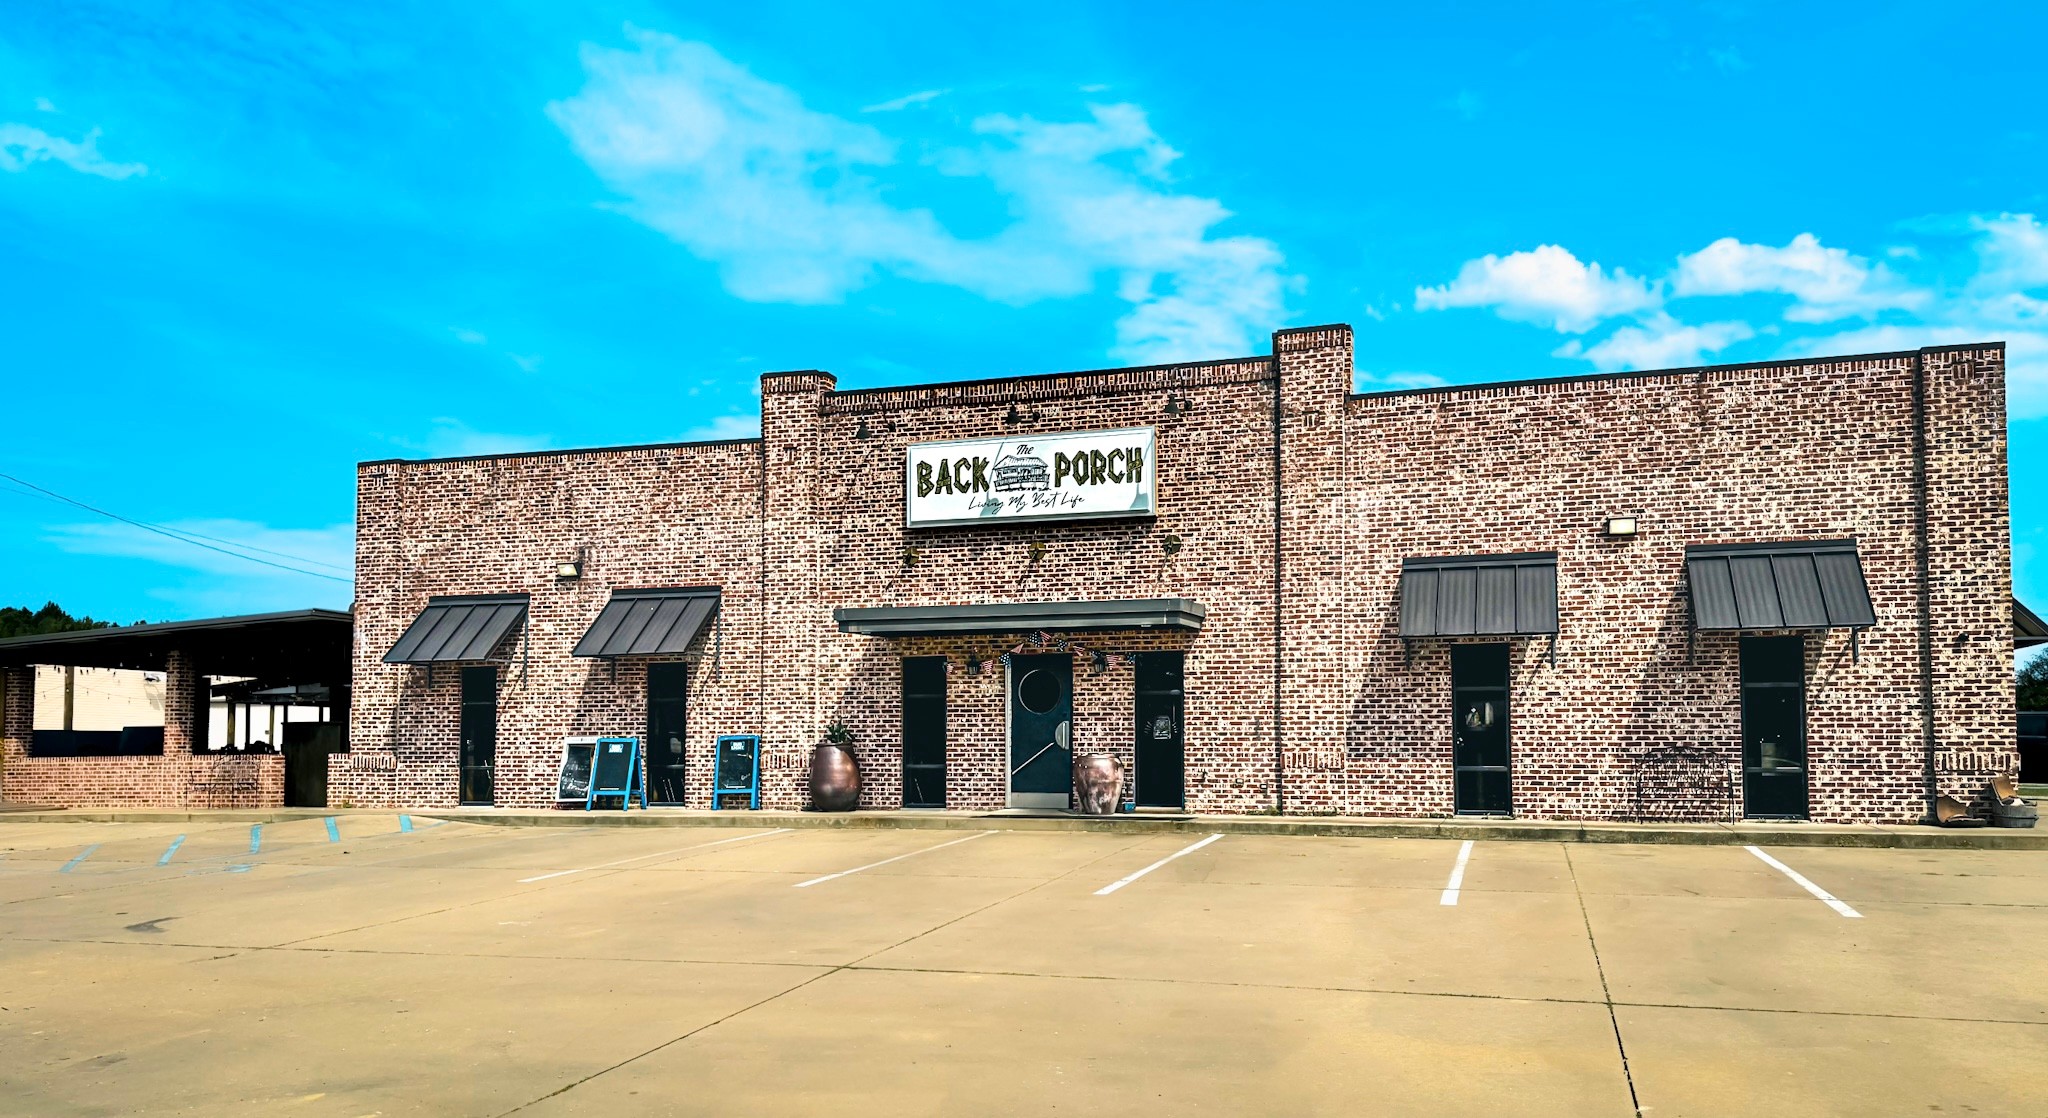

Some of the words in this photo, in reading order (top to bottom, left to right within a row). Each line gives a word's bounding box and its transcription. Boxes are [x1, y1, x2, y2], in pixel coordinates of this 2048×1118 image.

[1017, 444, 1034, 455] The
[917, 457, 990, 498] BACK
[1054, 447, 1143, 488] PORCH
[968, 496, 1004, 515] Living
[1008, 494, 1028, 513] My
[1032, 492, 1061, 508] Best
[1061, 491, 1085, 508] Life
